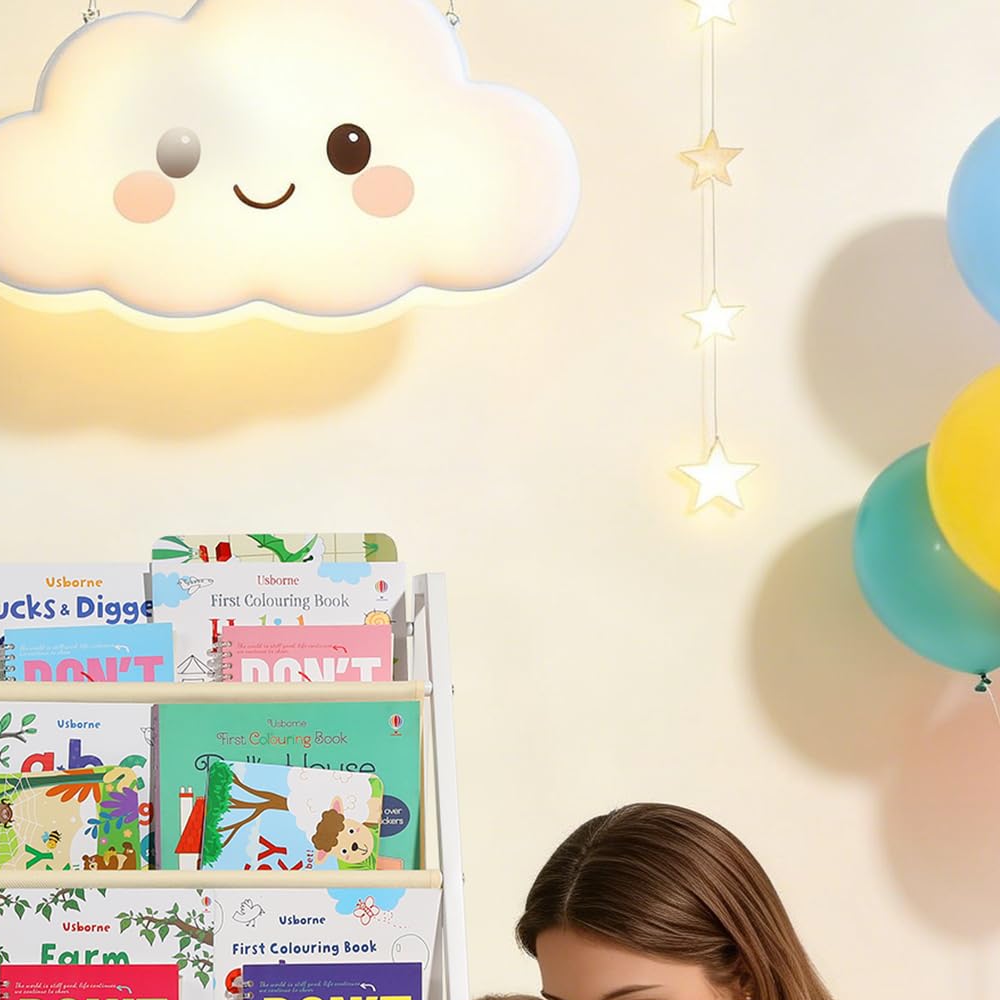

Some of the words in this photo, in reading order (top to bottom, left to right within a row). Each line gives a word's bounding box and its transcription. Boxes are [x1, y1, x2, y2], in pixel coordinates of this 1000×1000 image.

[46, 577, 103, 588] Usborne
[257, 575, 300, 586] Usborne
[211, 594, 241, 608] First
[245, 594, 311, 610] Colouring
[314, 594, 350, 607] Book
[60, 604, 70, 616] &
[57, 719, 101, 729] Usborne
[267, 719, 307, 728] Usborne
[216, 732, 246, 745] First
[249, 732, 311, 748] Colouring
[315, 731, 347, 745] Book
[279, 915, 326, 926] Usborne
[62, 922, 111, 933] Usborne
[232, 943, 265, 955] First
[270, 942, 339, 956] Colouring
[344, 941, 377, 954] Book
